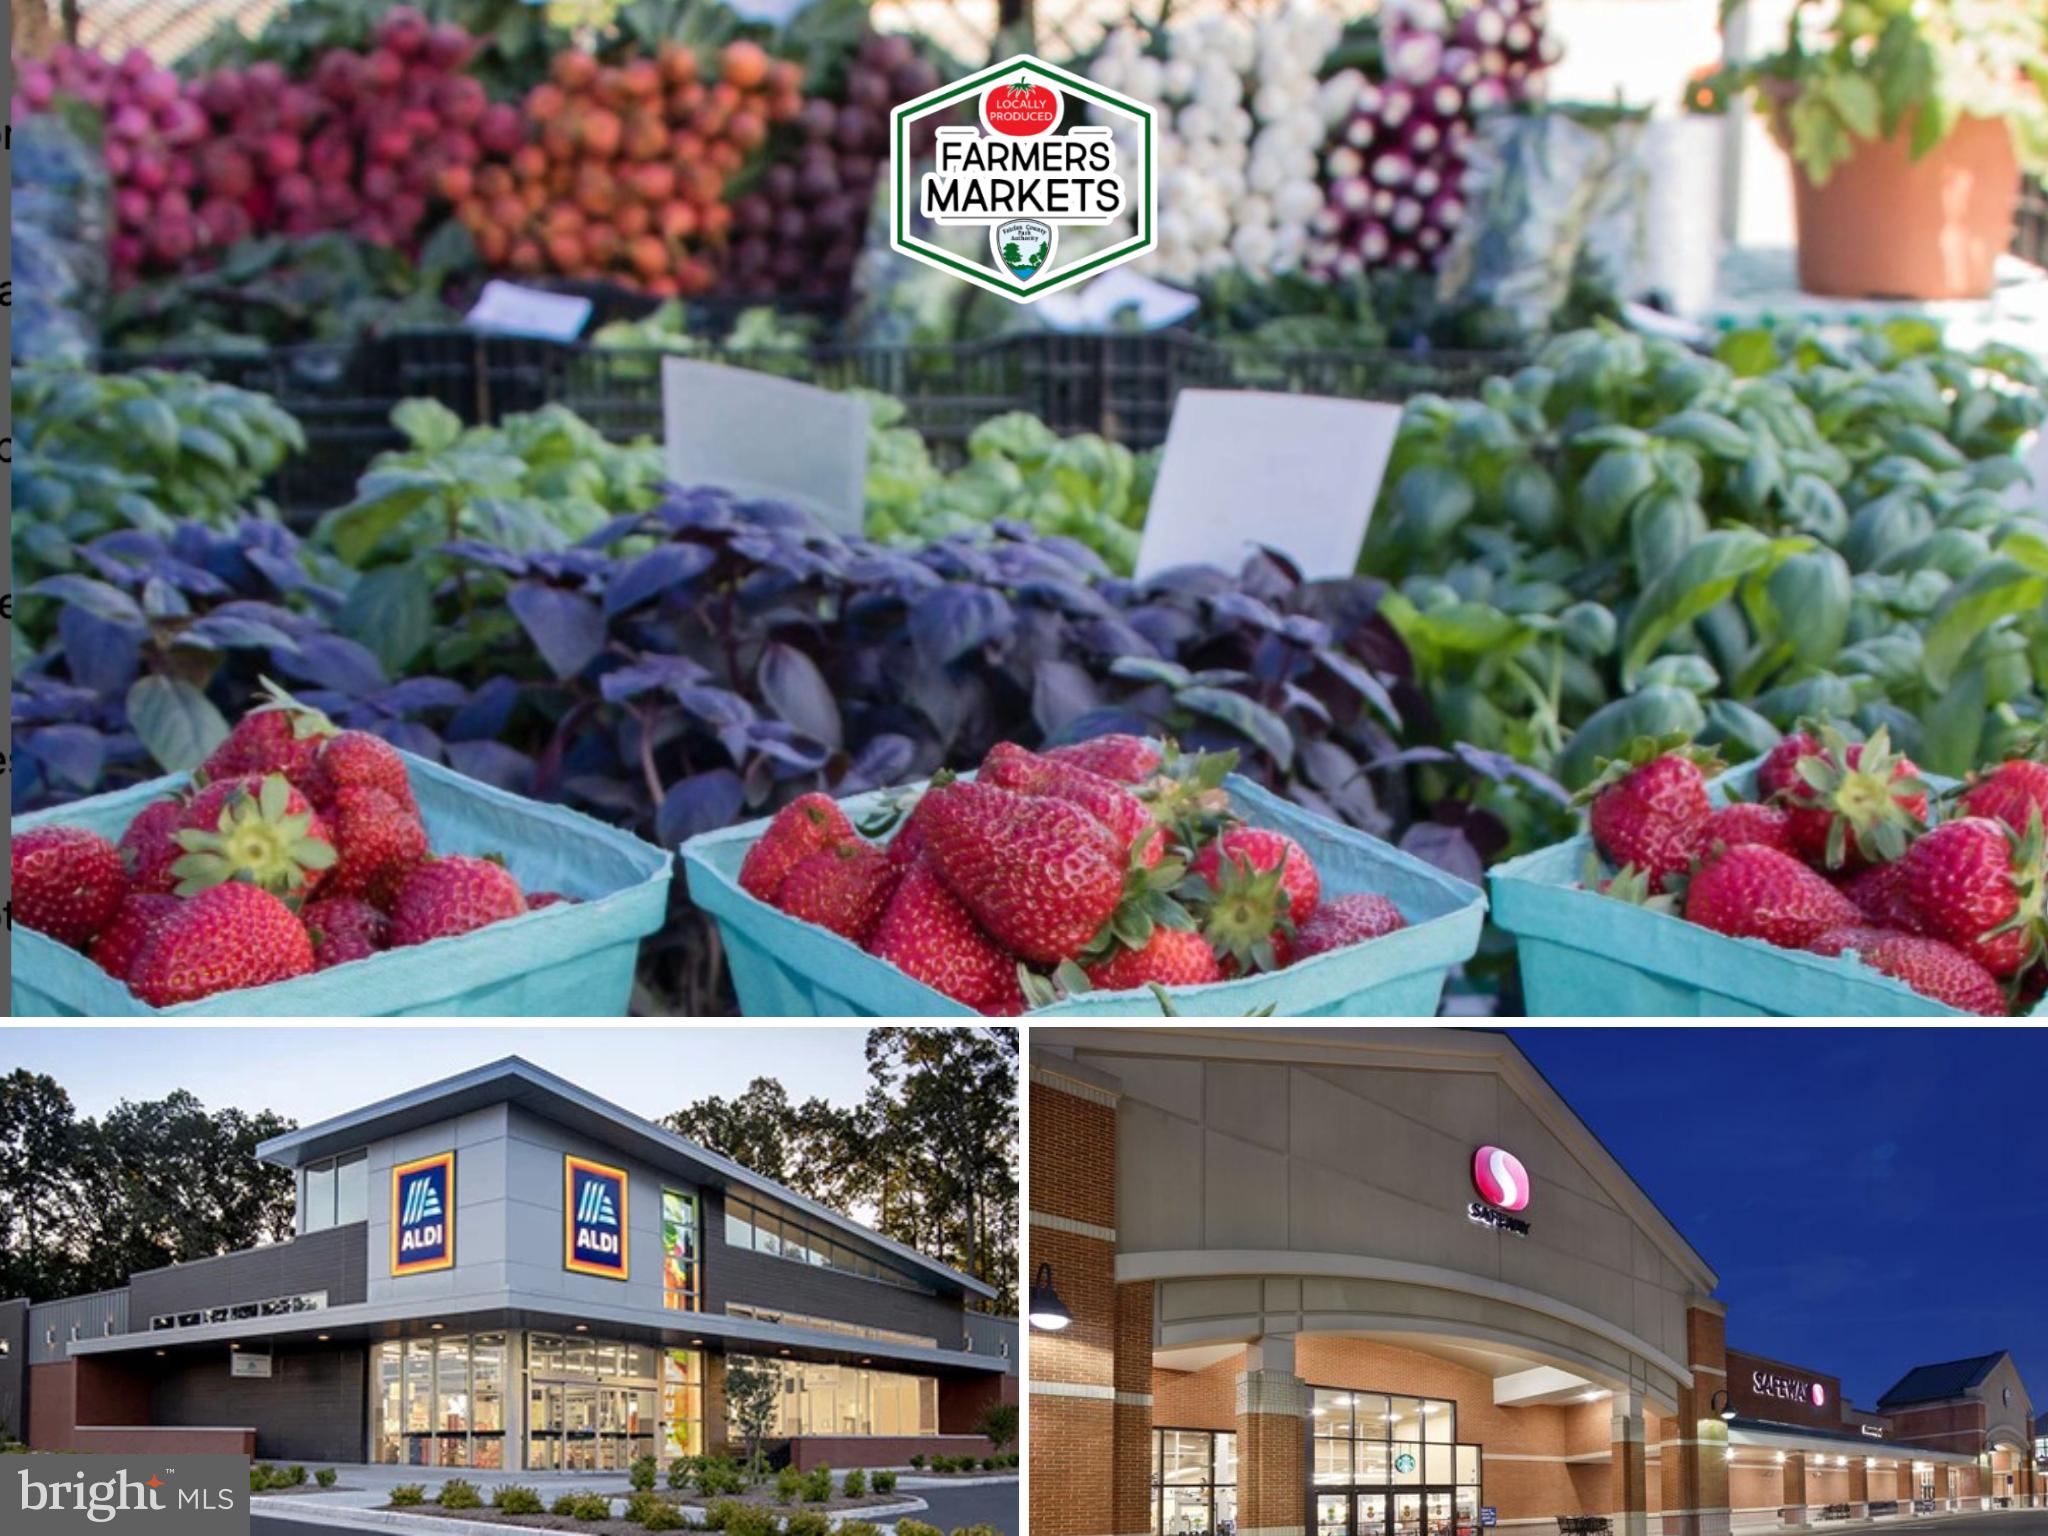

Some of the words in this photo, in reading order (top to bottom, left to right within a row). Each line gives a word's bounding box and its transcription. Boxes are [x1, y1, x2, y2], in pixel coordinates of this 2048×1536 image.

[401, 1224, 443, 1252] ALDI
[577, 1228, 619, 1254] ALDI
[1752, 1370, 1809, 1403] SAFEWAY
